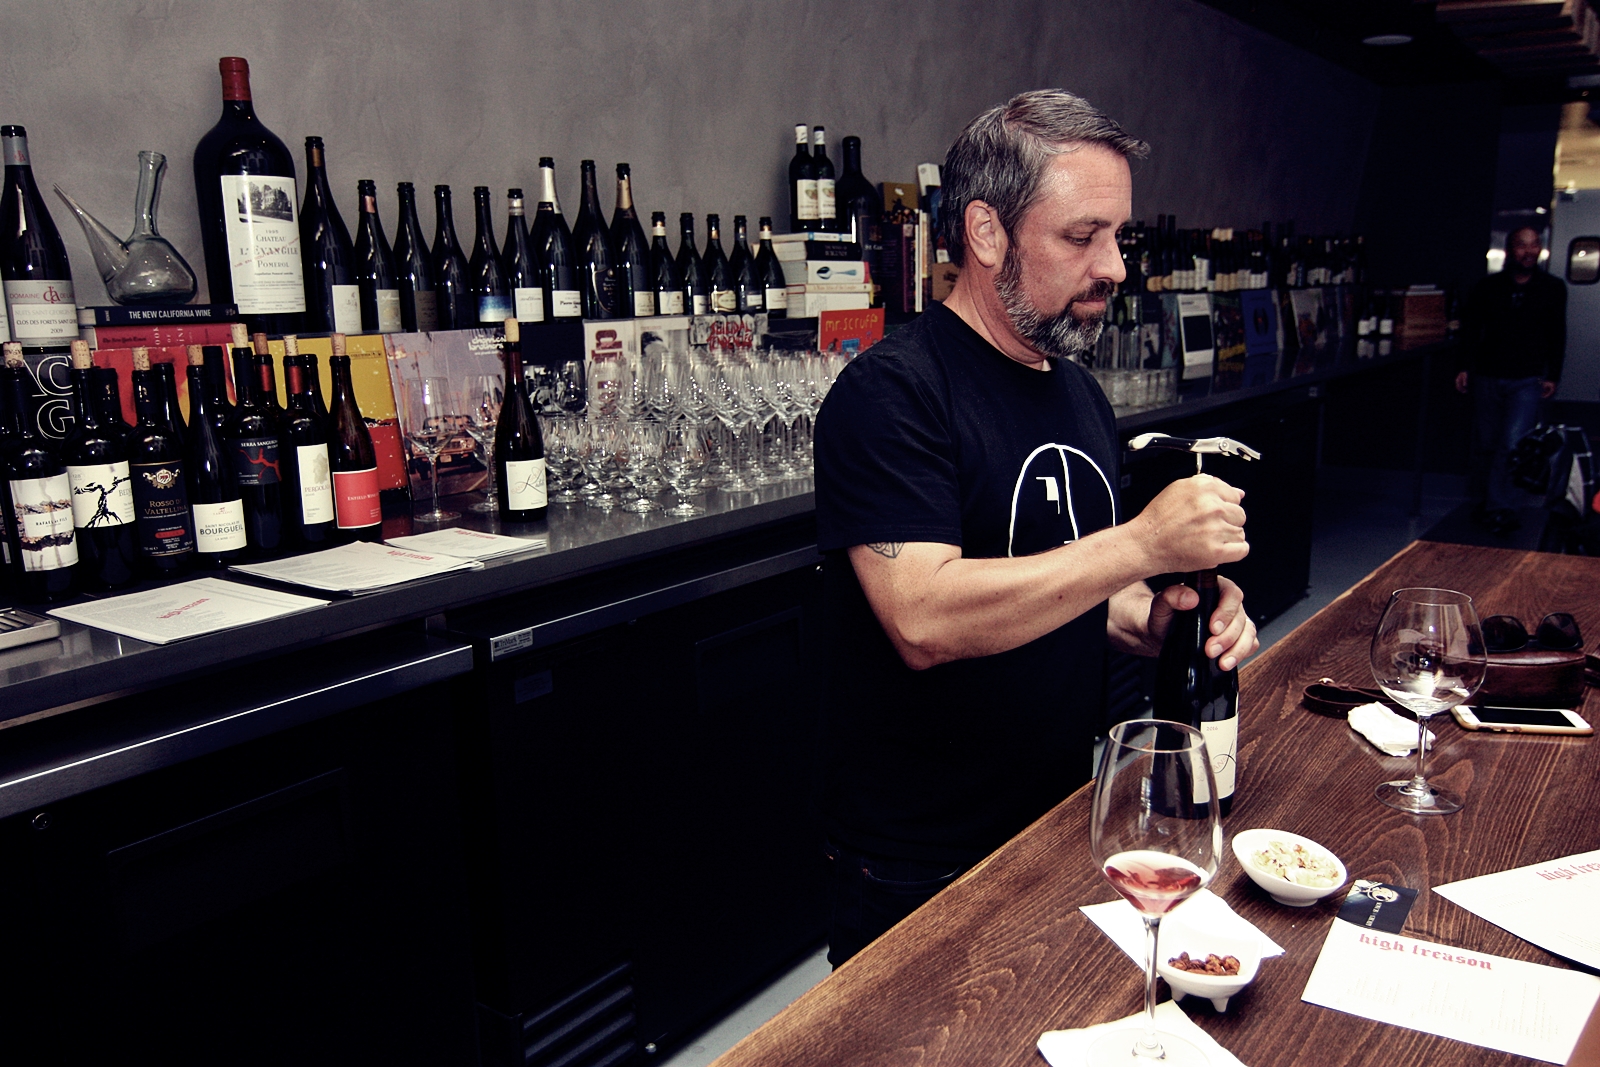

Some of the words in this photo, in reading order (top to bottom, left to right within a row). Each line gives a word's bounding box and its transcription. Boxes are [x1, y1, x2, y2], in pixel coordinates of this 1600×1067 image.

[255, 234, 287, 242] CHATEAU
[257, 259, 290, 268] POMEROL
[129, 311, 142, 320] THE
[142, 310, 158, 319] NEW
[158, 310, 195, 318] CALIFORNIA
[195, 309, 212, 317] WINE
[472, 334, 506, 344] chemical
[468, 342, 504, 351] brothers
[149, 500, 174, 508] ROSSO
[144, 504, 188, 515] VALTELLINA
[200, 524, 243, 536] BOURGUEIL
[1536, 864, 1578, 882] high
[1359, 932, 1405, 952] high
[1412, 944, 1493, 971] treason
